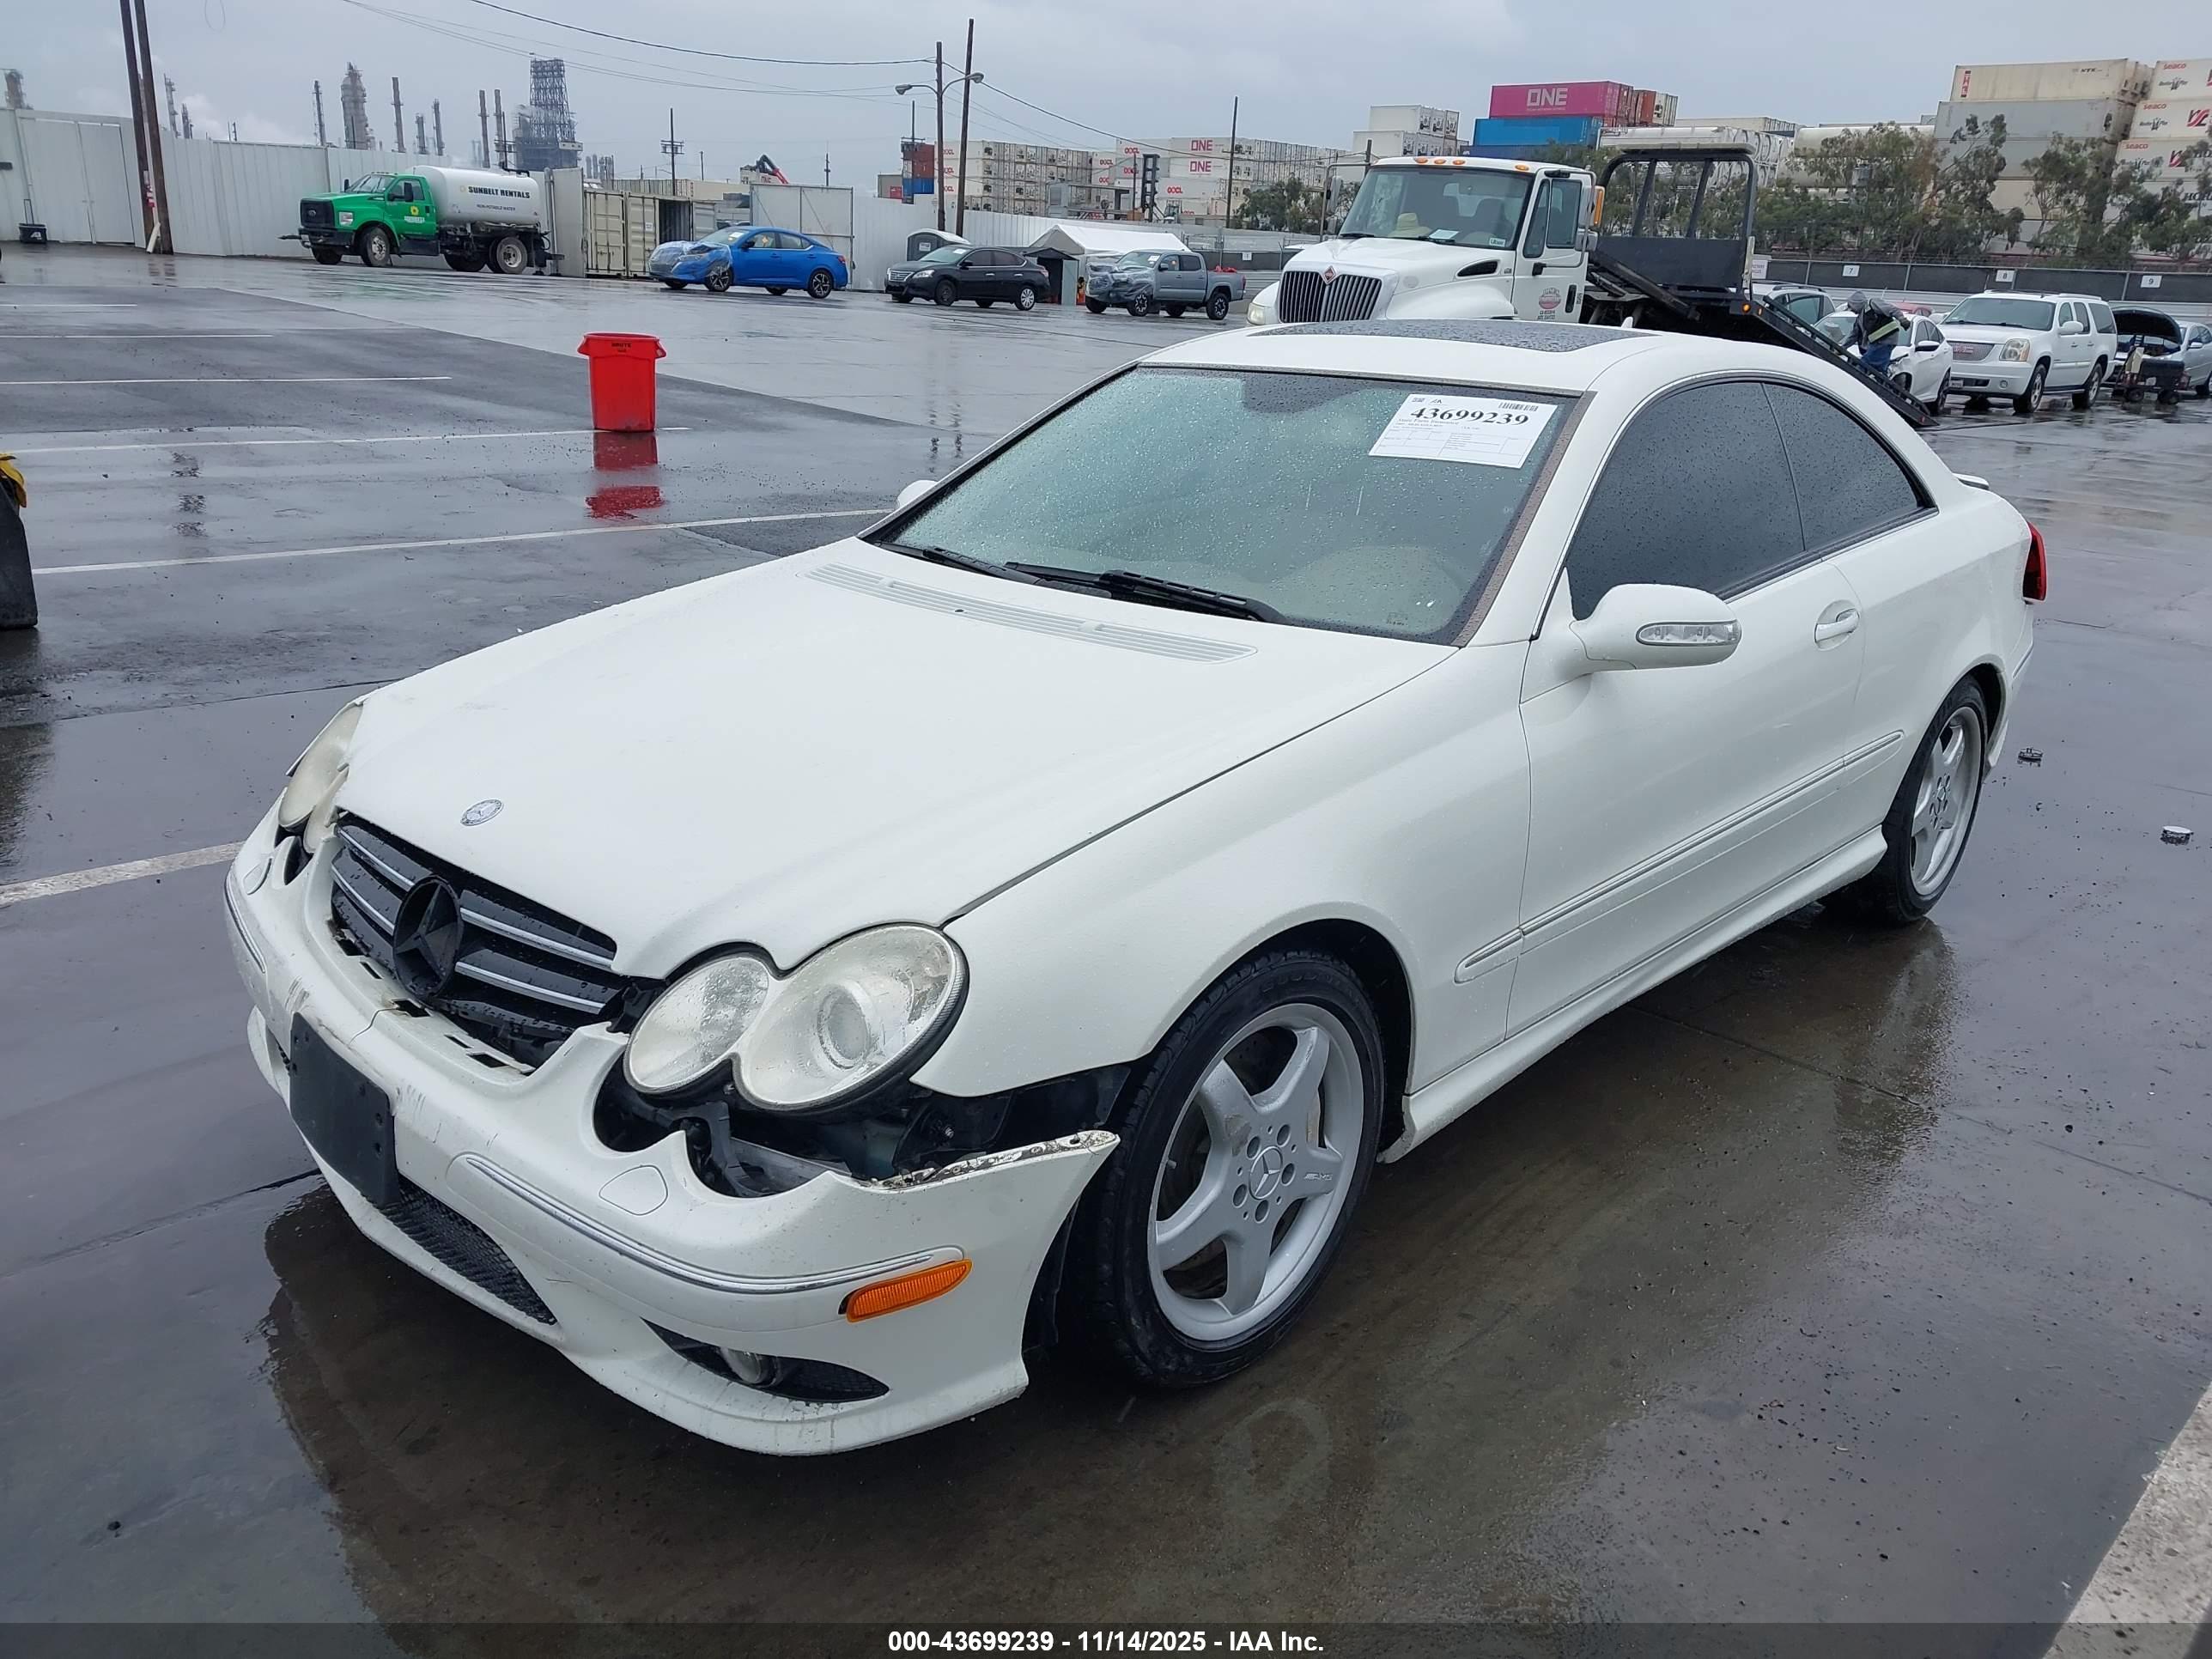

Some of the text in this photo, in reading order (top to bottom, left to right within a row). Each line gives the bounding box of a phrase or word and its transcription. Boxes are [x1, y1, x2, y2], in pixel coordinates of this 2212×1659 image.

[1527, 88, 1568, 106] ONE
[1191, 140, 1212, 151] ONE
[1190, 161, 1212, 173] ONE
[468, 185, 530, 198] SUNBELT RENTALS
[1410, 407, 1529, 426] 43699239
